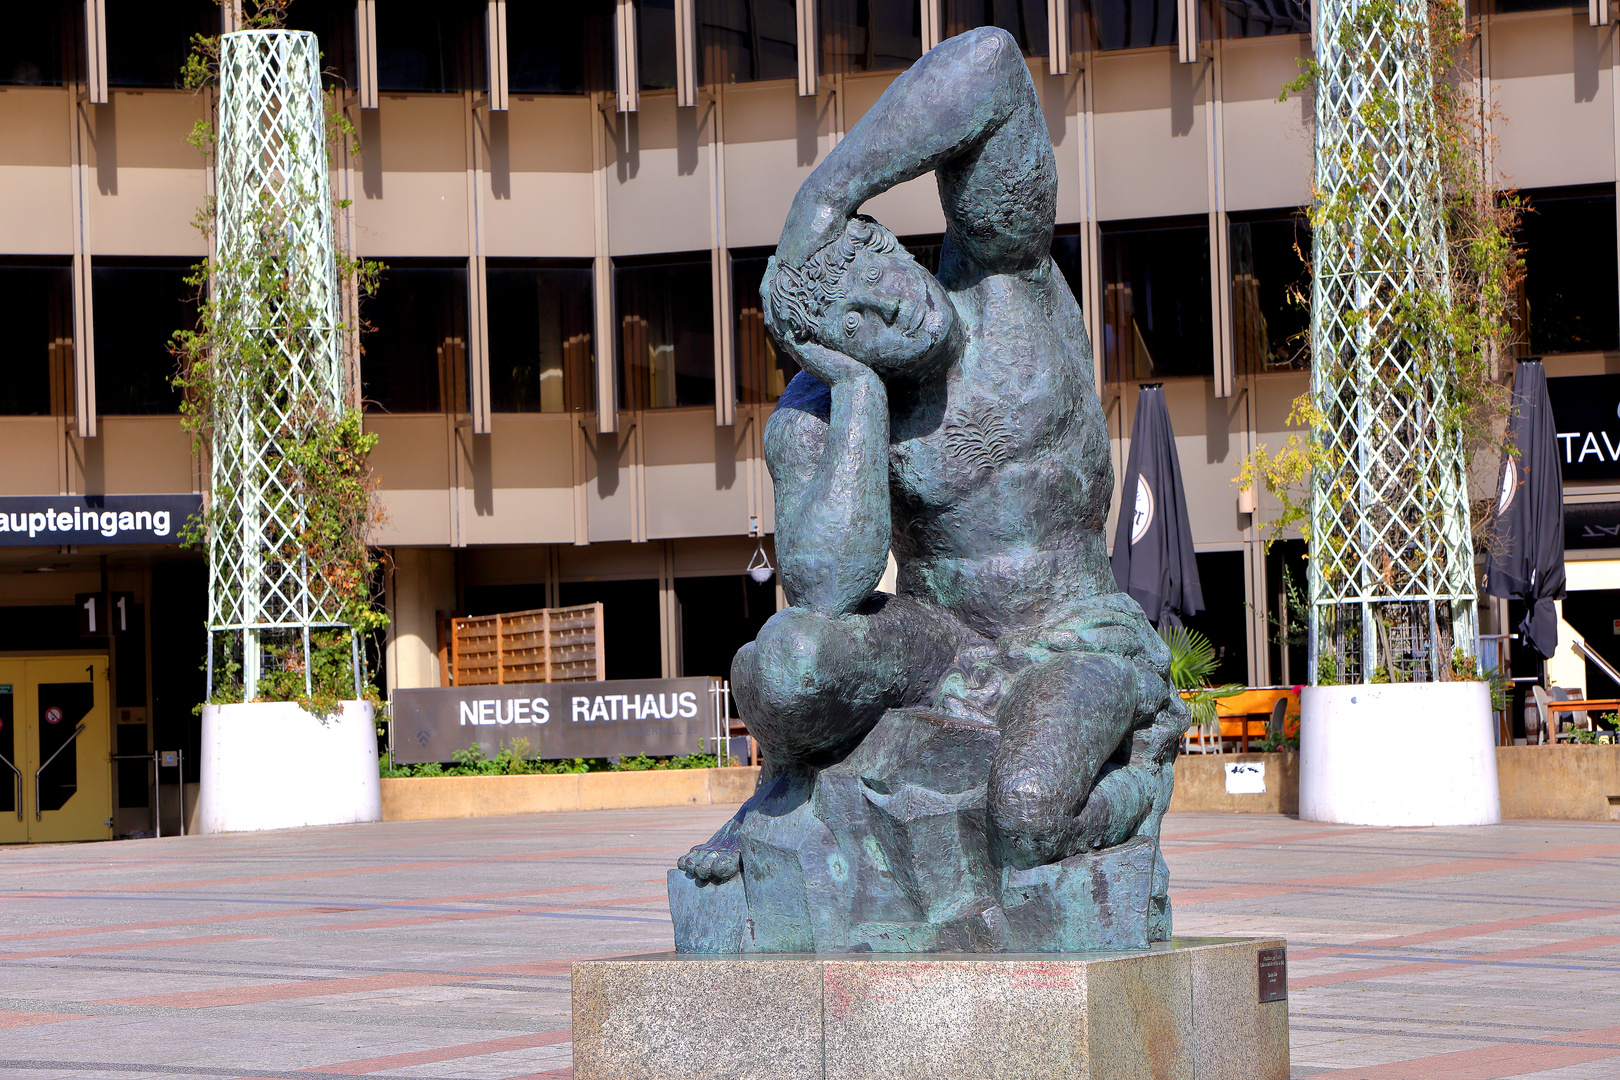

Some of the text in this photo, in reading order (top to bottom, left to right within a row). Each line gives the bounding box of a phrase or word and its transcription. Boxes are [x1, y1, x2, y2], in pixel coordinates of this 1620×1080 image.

[84, 597, 96, 632] 1
[117, 596, 127, 631] 1
[86, 664, 94, 681] 1
[459, 691, 698, 726] NEUES RATHAUS
